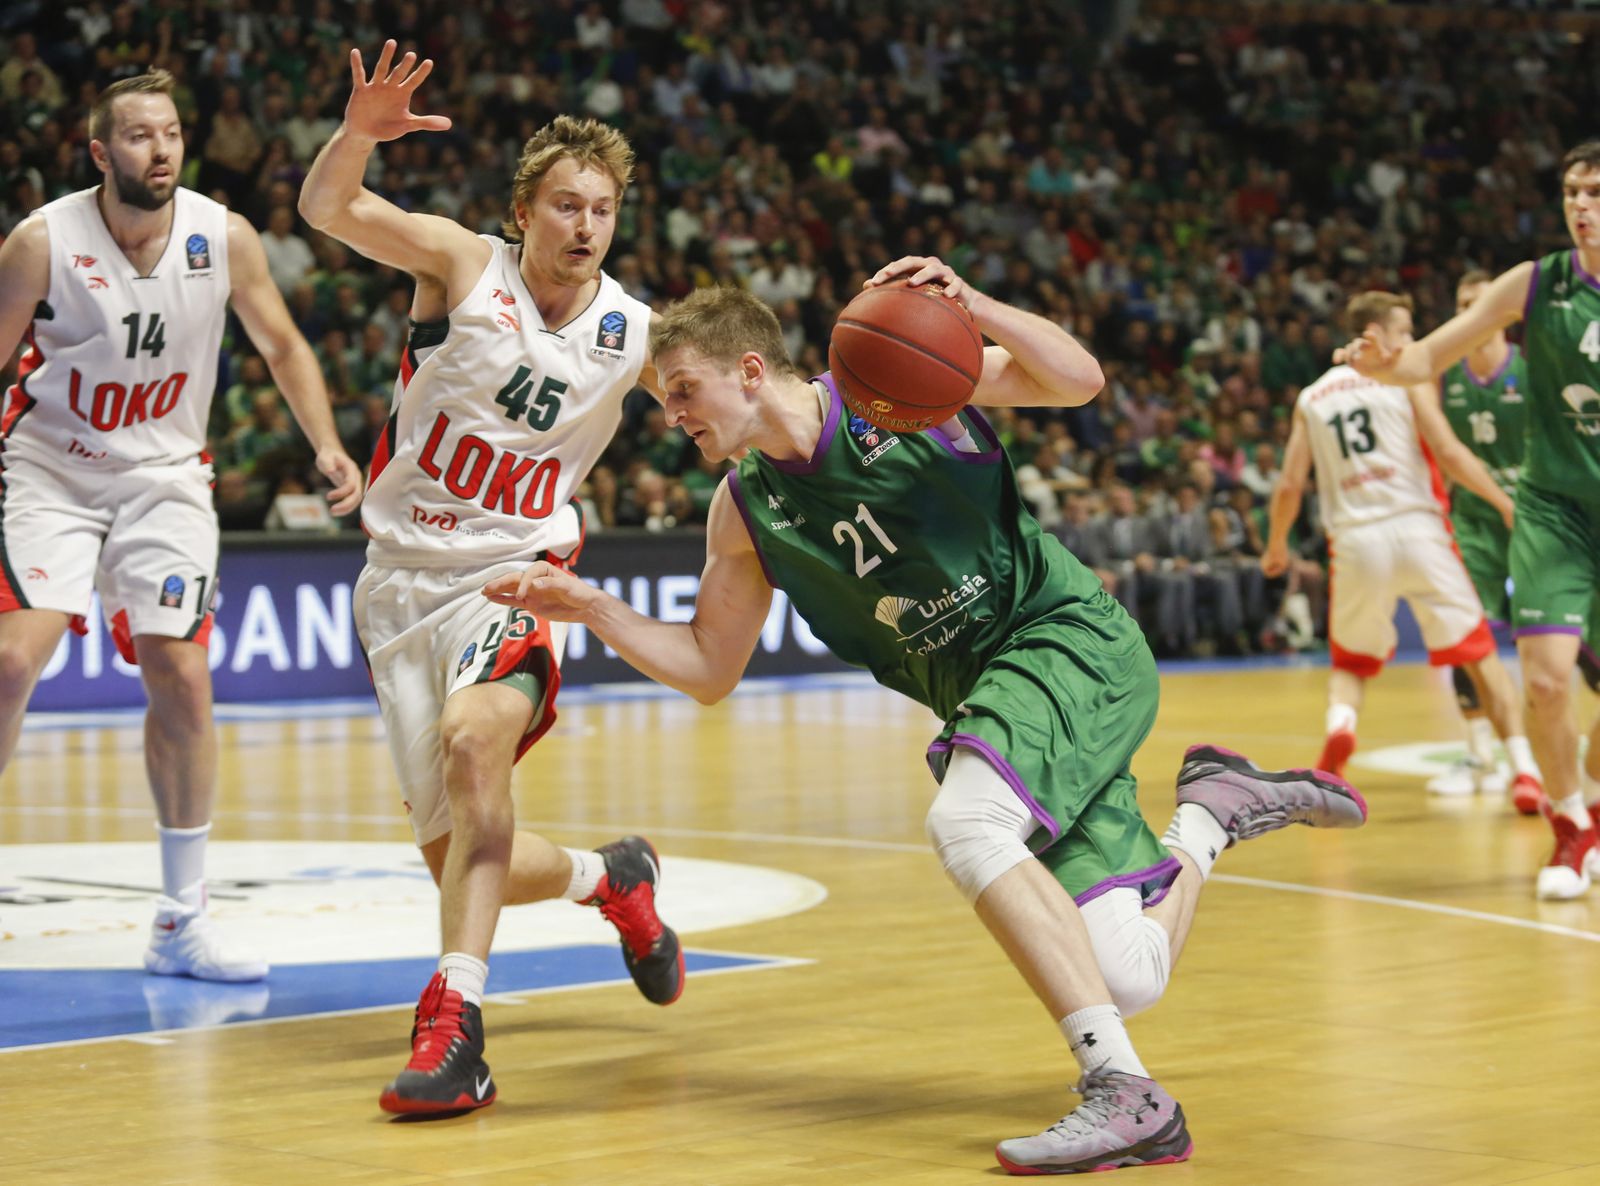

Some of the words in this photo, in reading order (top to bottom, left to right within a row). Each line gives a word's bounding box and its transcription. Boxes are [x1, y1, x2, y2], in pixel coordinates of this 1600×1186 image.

[121, 312, 166, 359] 14
[69, 367, 188, 432] LOKO
[494, 365, 569, 432] 45
[1327, 408, 1377, 460] 13
[417, 410, 562, 520] LOKO
[832, 503, 898, 579] 21
[918, 575, 987, 618] Unicaja
[482, 608, 538, 653] 45
